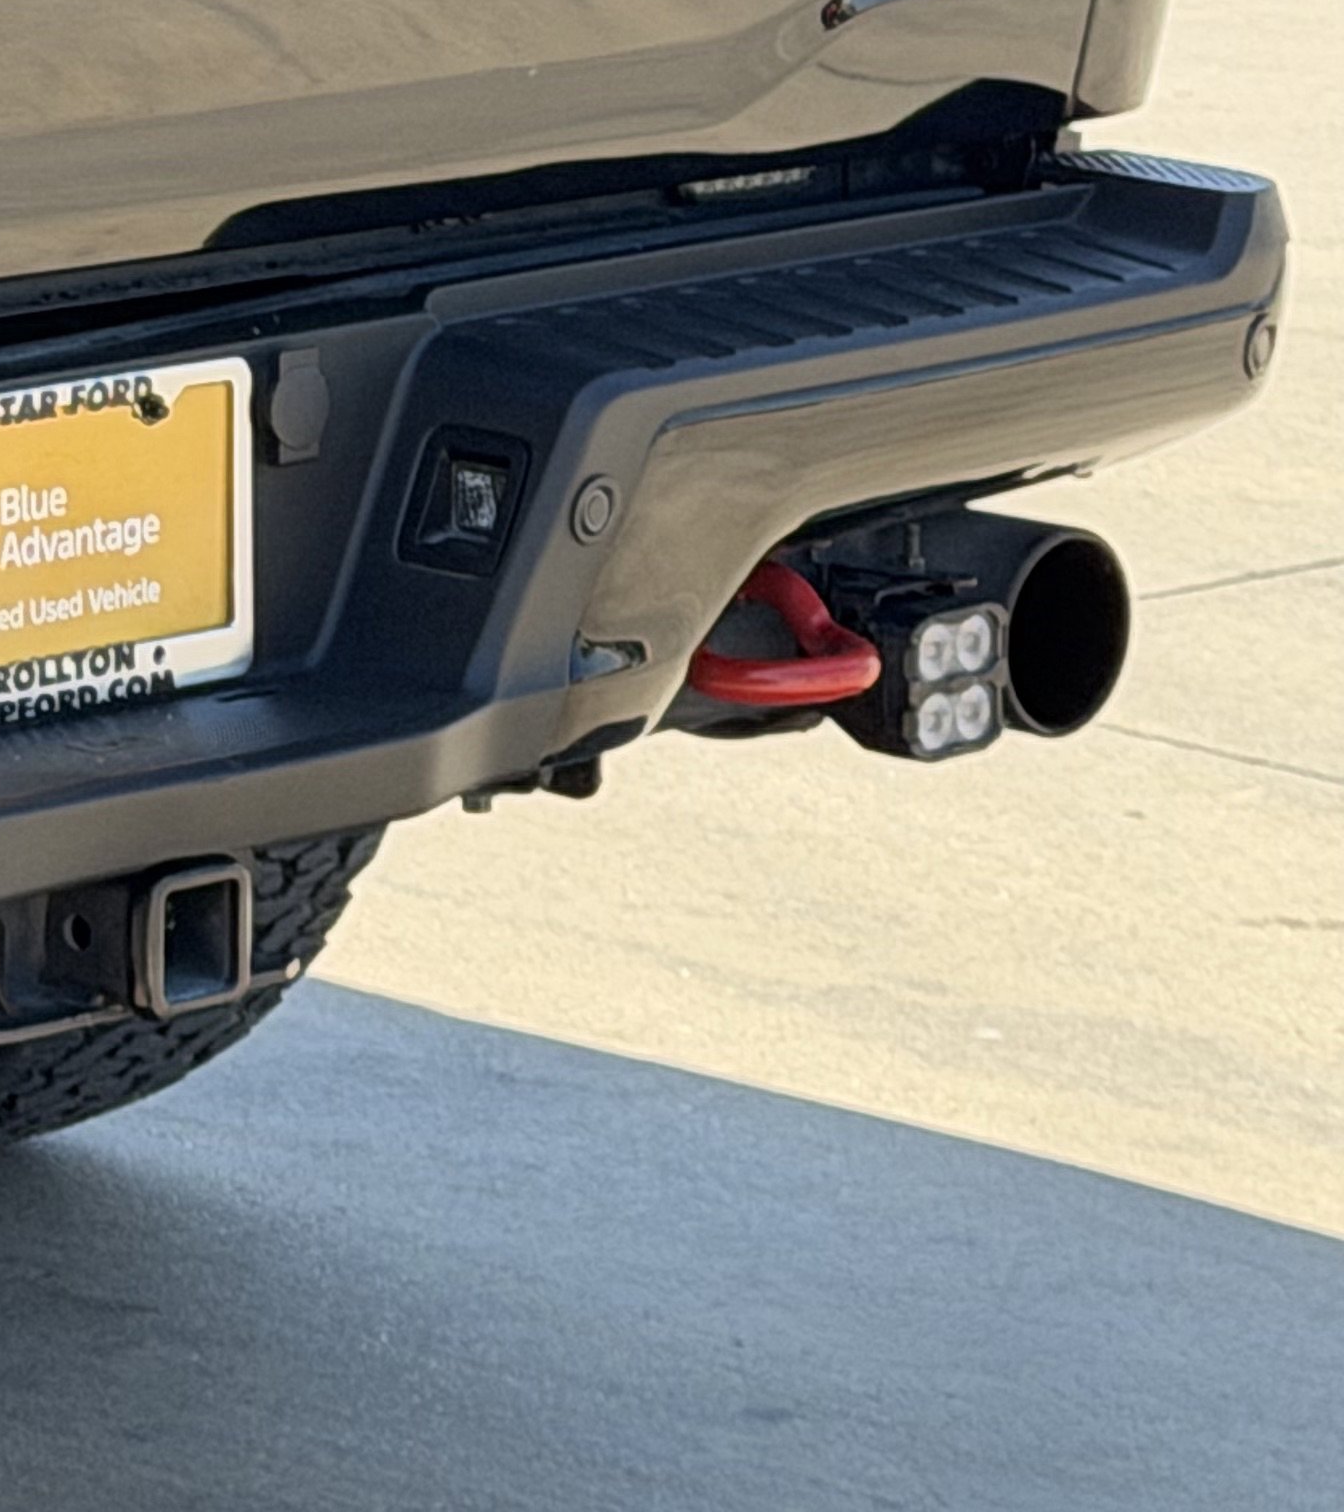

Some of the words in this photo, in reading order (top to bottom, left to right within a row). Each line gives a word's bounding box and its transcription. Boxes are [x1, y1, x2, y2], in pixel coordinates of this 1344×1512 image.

[63, 376, 153, 415] FORD
[0, 484, 68, 526] Blue
[0, 513, 161, 571] Advantage
[29, 591, 83, 625] Used
[87, 577, 161, 615] Vehicle
